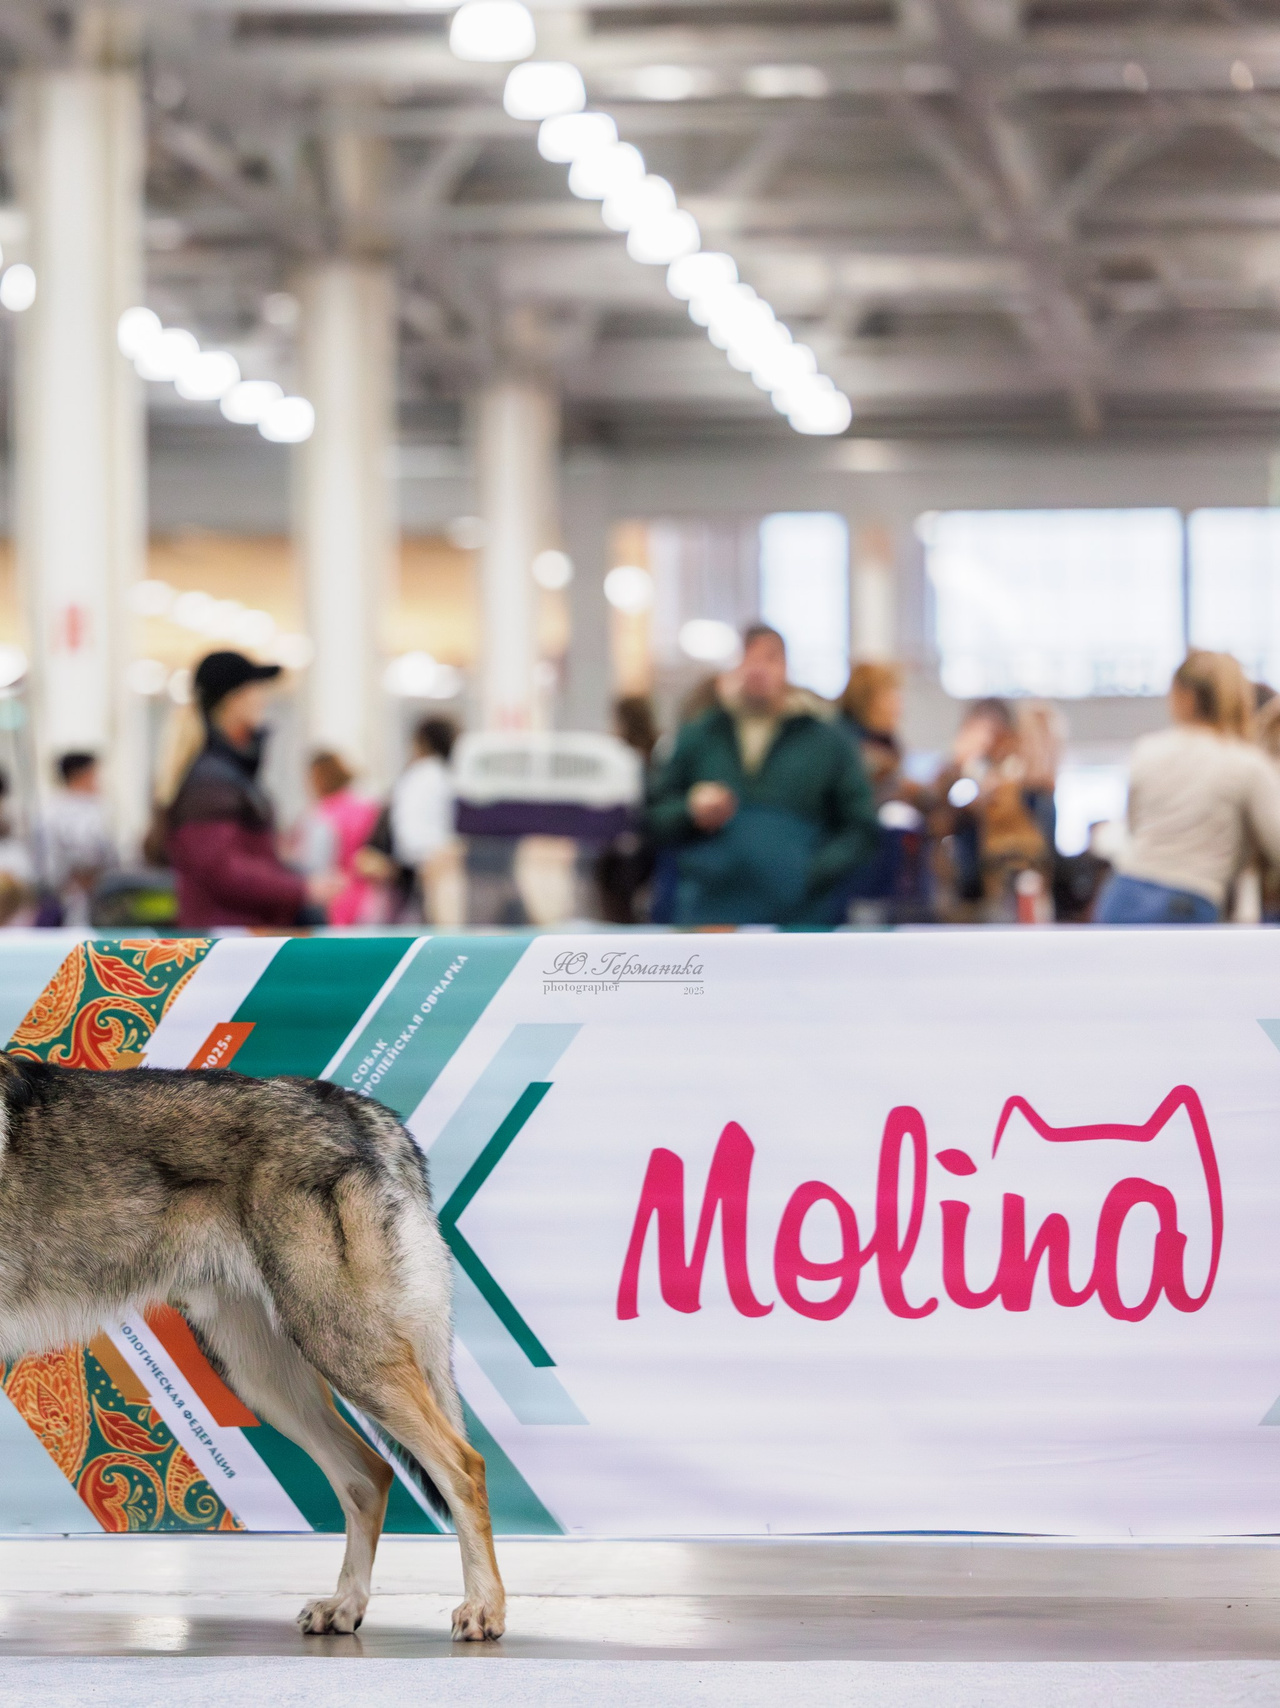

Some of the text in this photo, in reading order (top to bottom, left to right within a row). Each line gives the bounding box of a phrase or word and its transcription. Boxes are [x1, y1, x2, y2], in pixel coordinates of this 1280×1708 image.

[420, 954, 468, 1013] ОВЧАРКА
[351, 1038, 388, 1083] СОБАК
[616, 1084, 1224, 1323] Molina
[121, 1321, 237, 1479] ОЛОГИЧЕСКАЯ ФЕДЕРАЦИЯ
